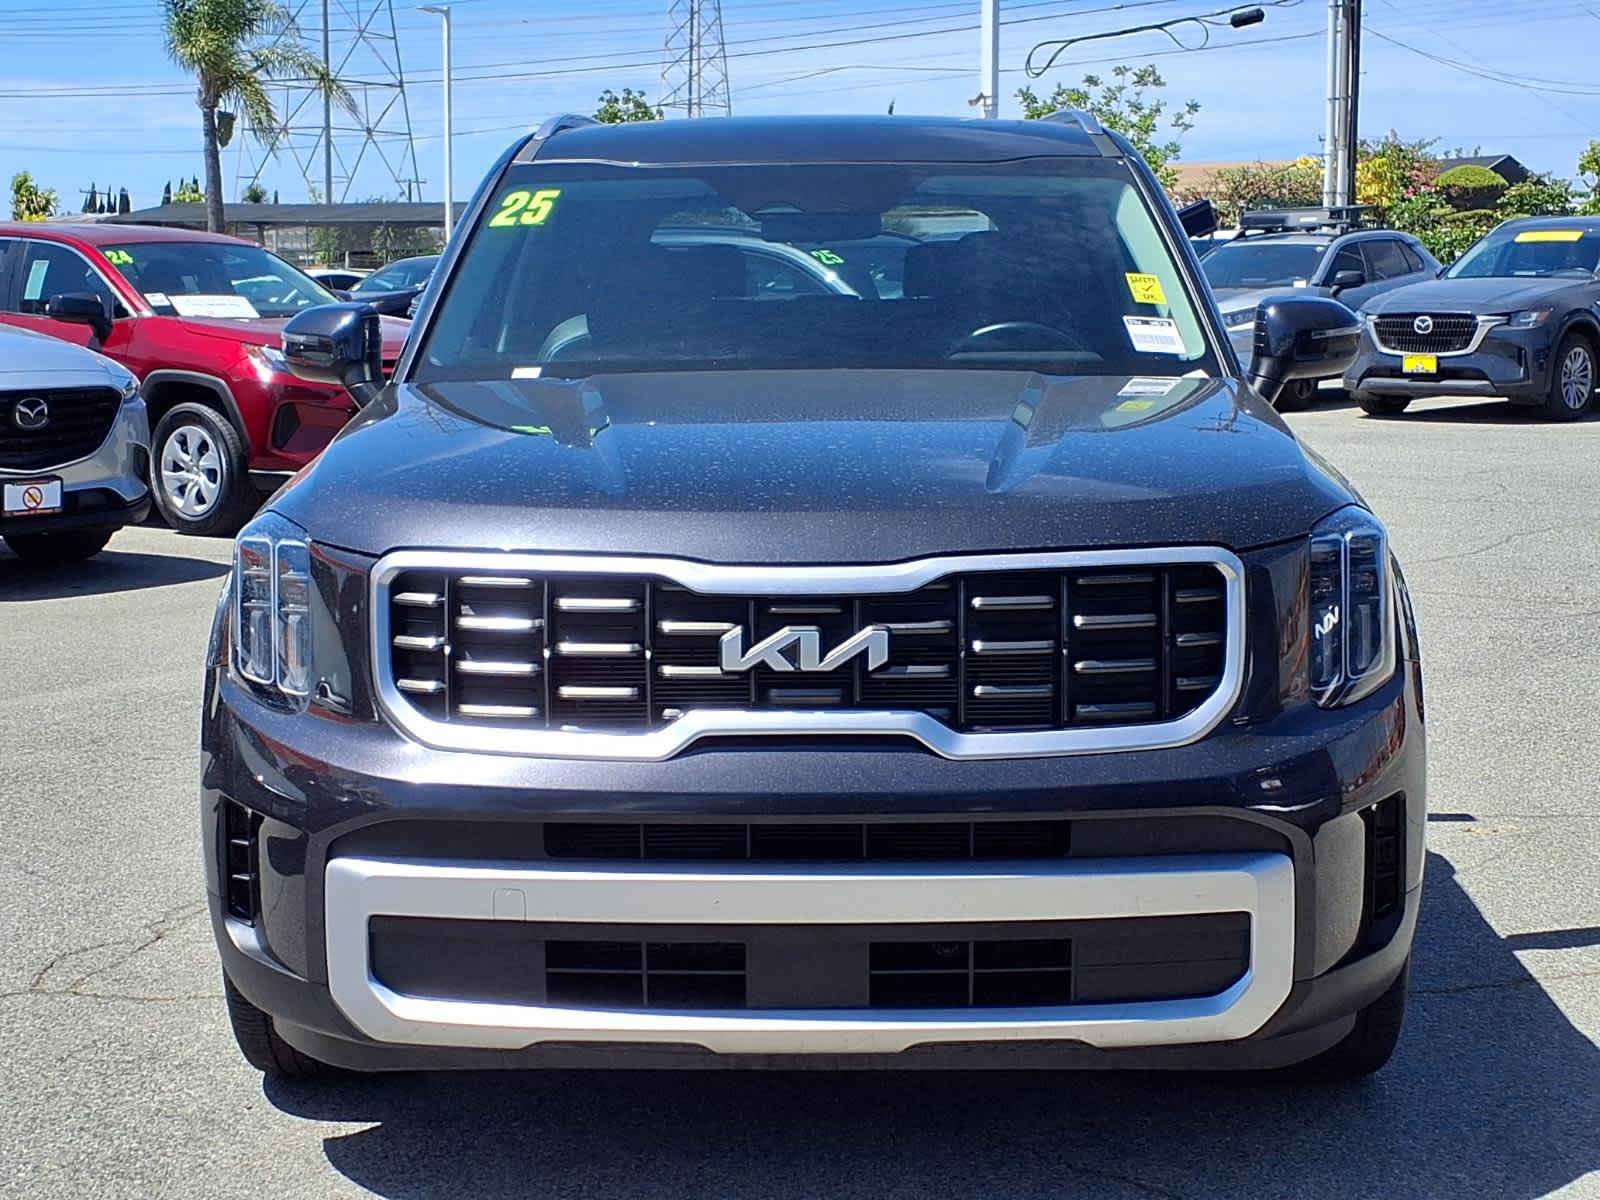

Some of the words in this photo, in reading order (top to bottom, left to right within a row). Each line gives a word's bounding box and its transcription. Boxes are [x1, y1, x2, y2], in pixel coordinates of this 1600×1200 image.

[489, 189, 561, 227] 25
[104, 250, 134, 265] 24
[810, 249, 845, 265] 25
[720, 625, 889, 672] KIA
